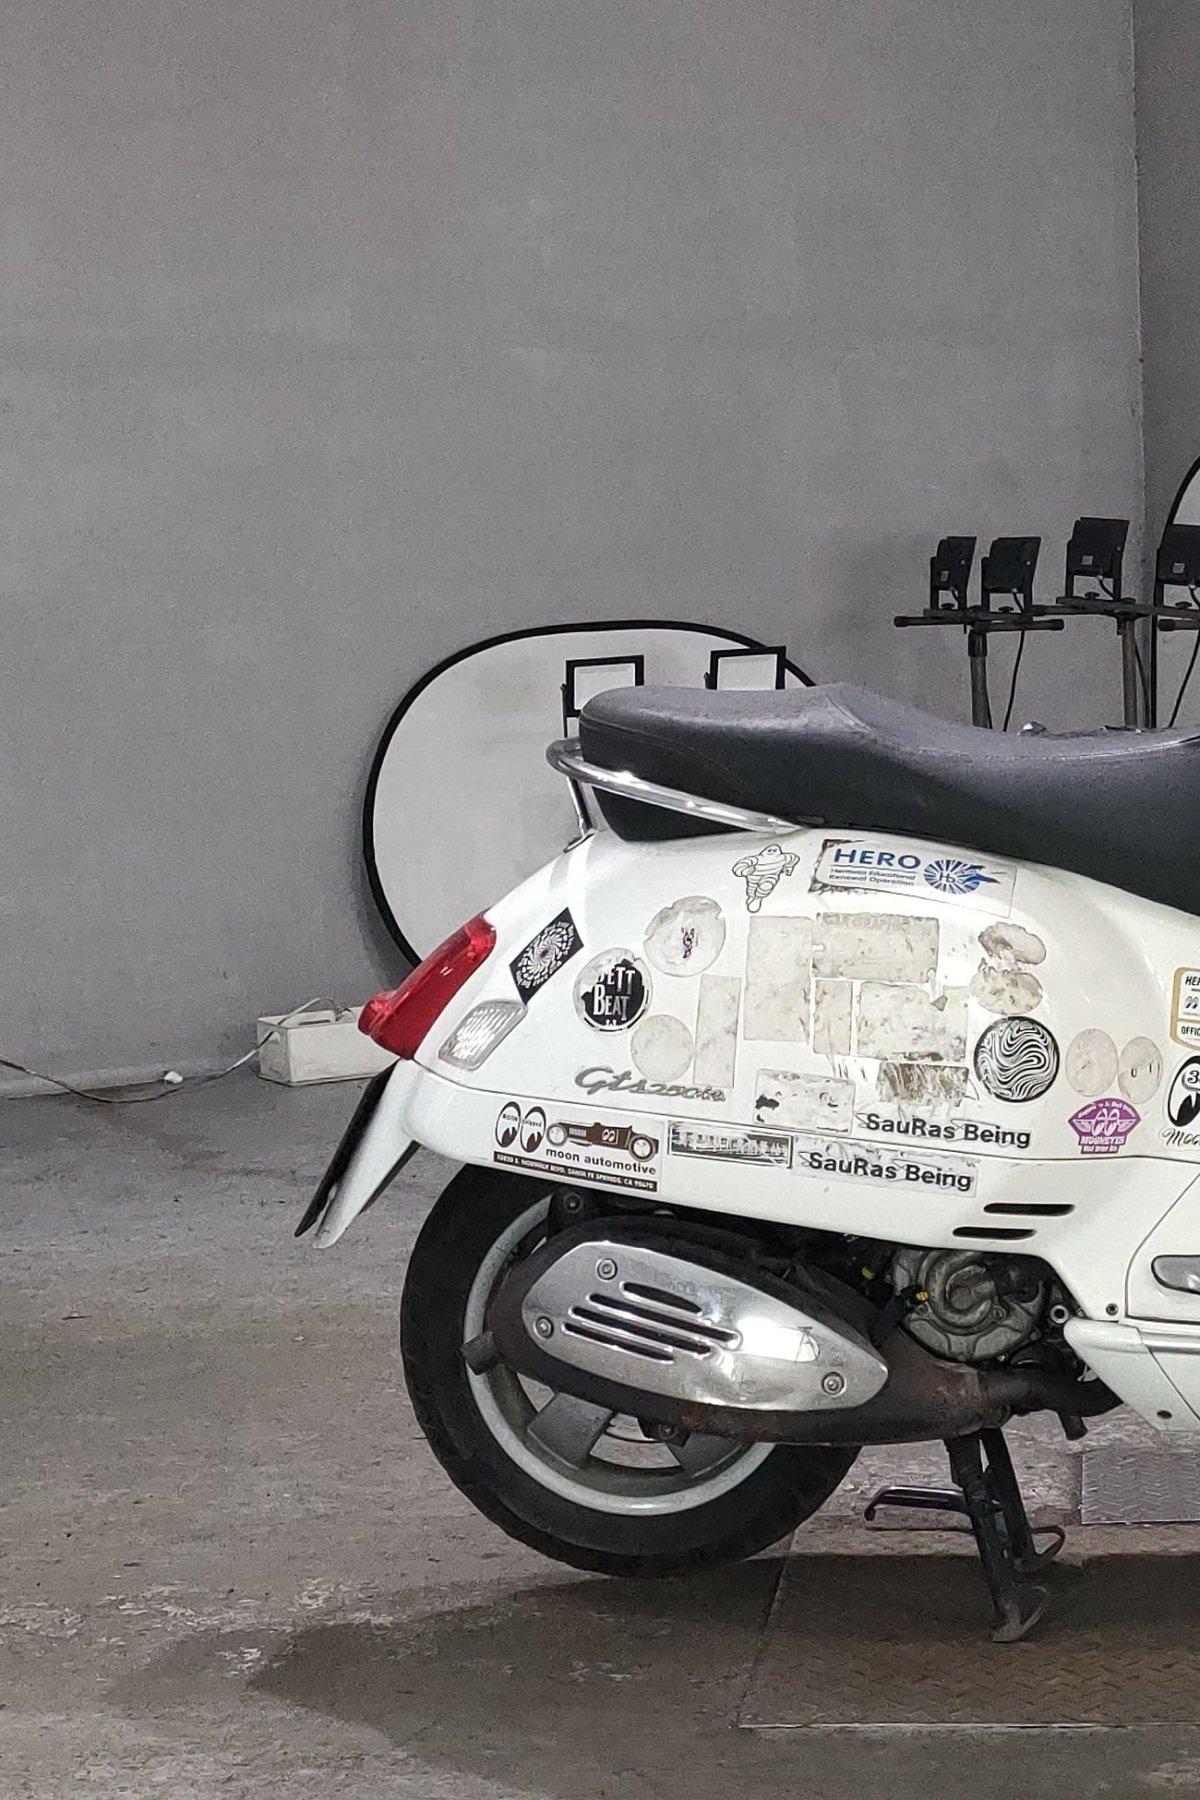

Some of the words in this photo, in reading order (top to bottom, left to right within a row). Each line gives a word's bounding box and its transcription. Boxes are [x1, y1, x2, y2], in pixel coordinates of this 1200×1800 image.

[833, 848, 922, 869] HERO
[592, 983, 631, 1021] BEAT
[865, 1112, 956, 1140] SauRas
[963, 1122, 1032, 1149] Being
[545, 1147, 580, 1162] moon
[583, 1154, 658, 1176] automotive
[808, 1152, 898, 1180] SauRas
[905, 1164, 973, 1192] Being
[623, 1177, 634, 1186] CA
